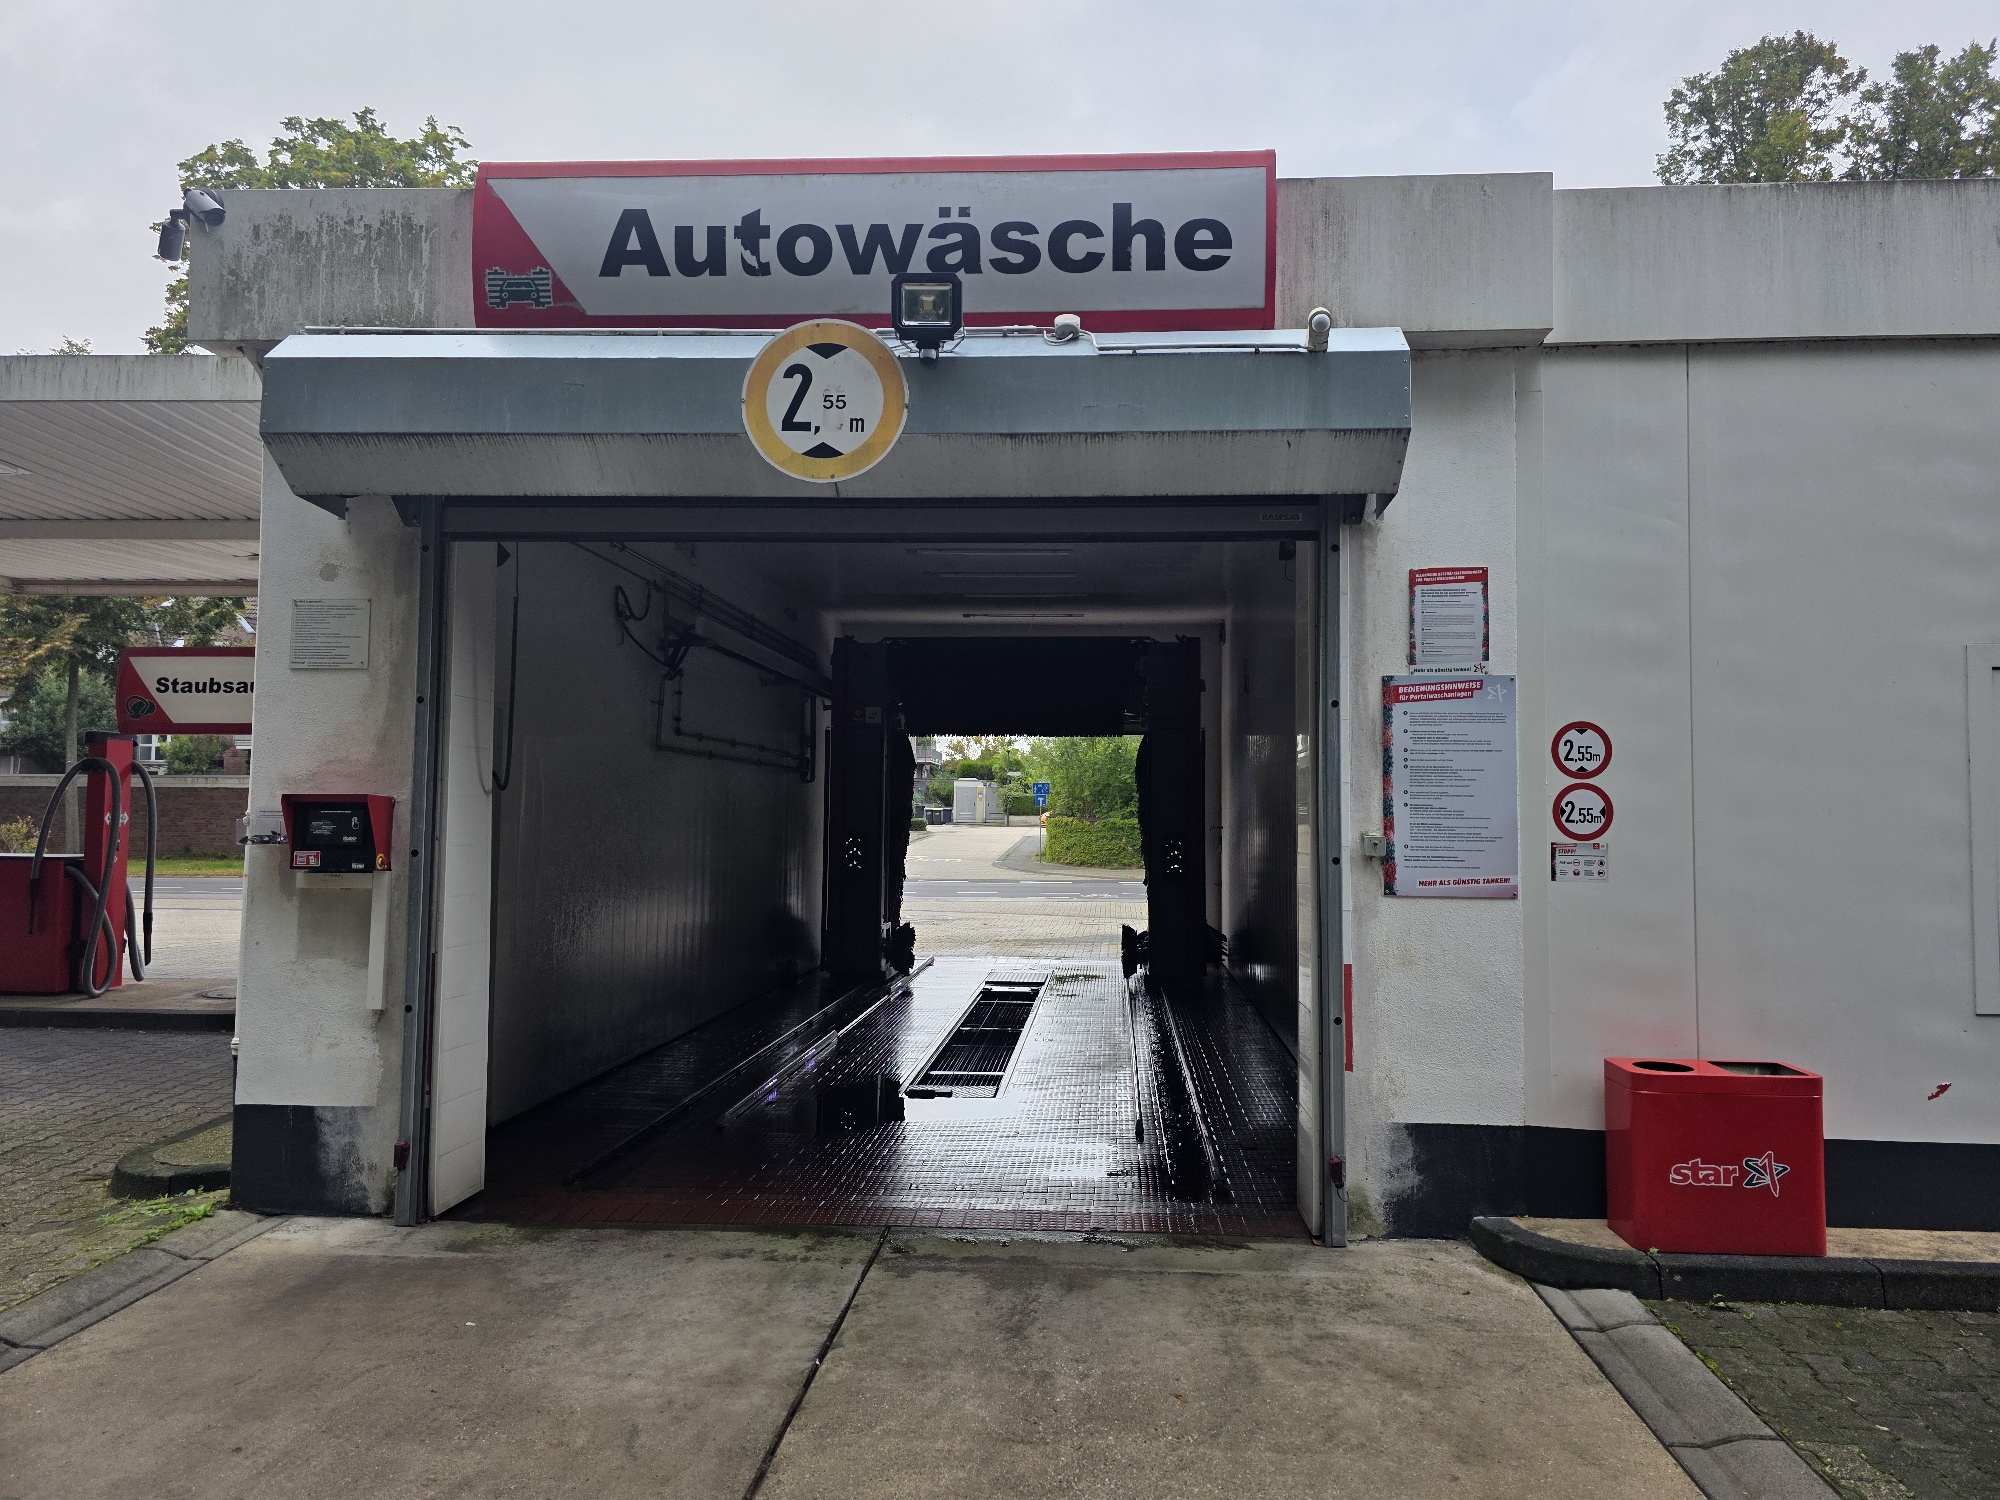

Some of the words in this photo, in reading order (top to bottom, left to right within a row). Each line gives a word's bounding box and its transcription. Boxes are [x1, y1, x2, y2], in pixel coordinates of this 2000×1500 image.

[599, 202, 1233, 278] Autowäsche
[1398, 681, 1481, 693] BEDIENUNGSHINWEISE
[1409, 691, 1471, 700] Portalwaschanlagen
[1482, 877, 1510, 885] TANKEN!
[1669, 1158, 1738, 1186] star
